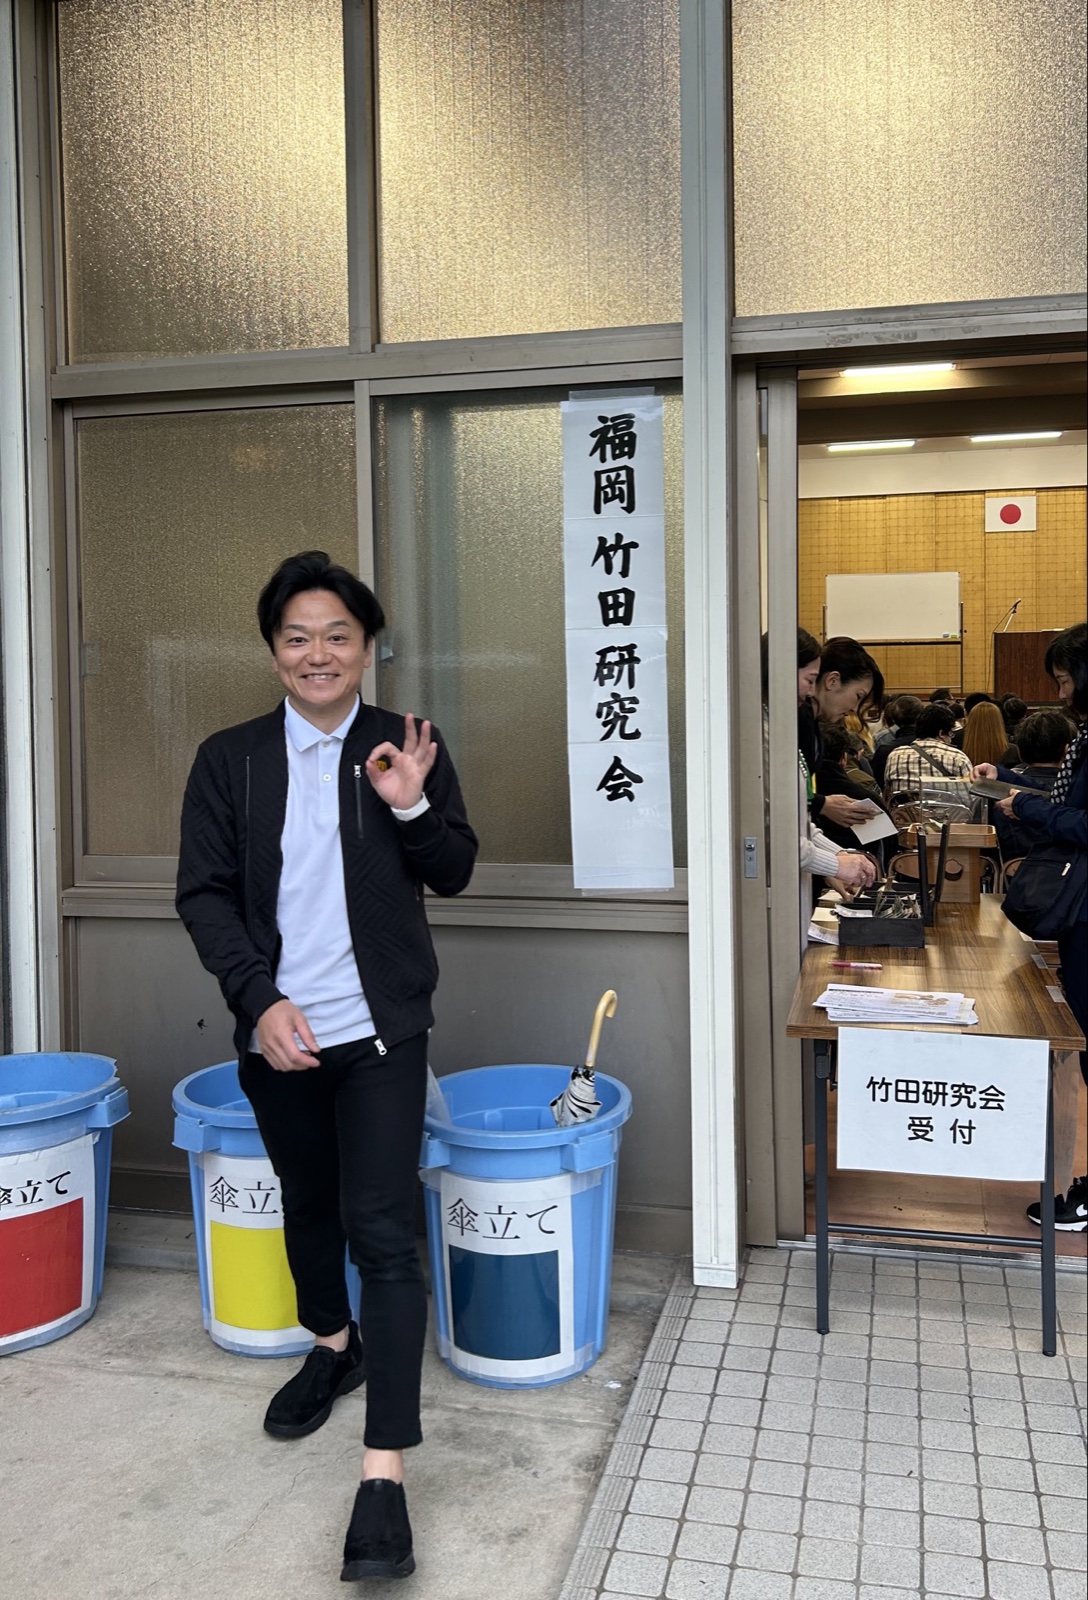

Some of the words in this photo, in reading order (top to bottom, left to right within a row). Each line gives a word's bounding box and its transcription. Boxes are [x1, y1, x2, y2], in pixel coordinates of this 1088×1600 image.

[866, 1076, 1006, 1112] 竹田研究会
[907, 1116, 977, 1145] 受付
[208, 1175, 279, 1215] 傘立
[446, 1197, 559, 1241] 傘立て
